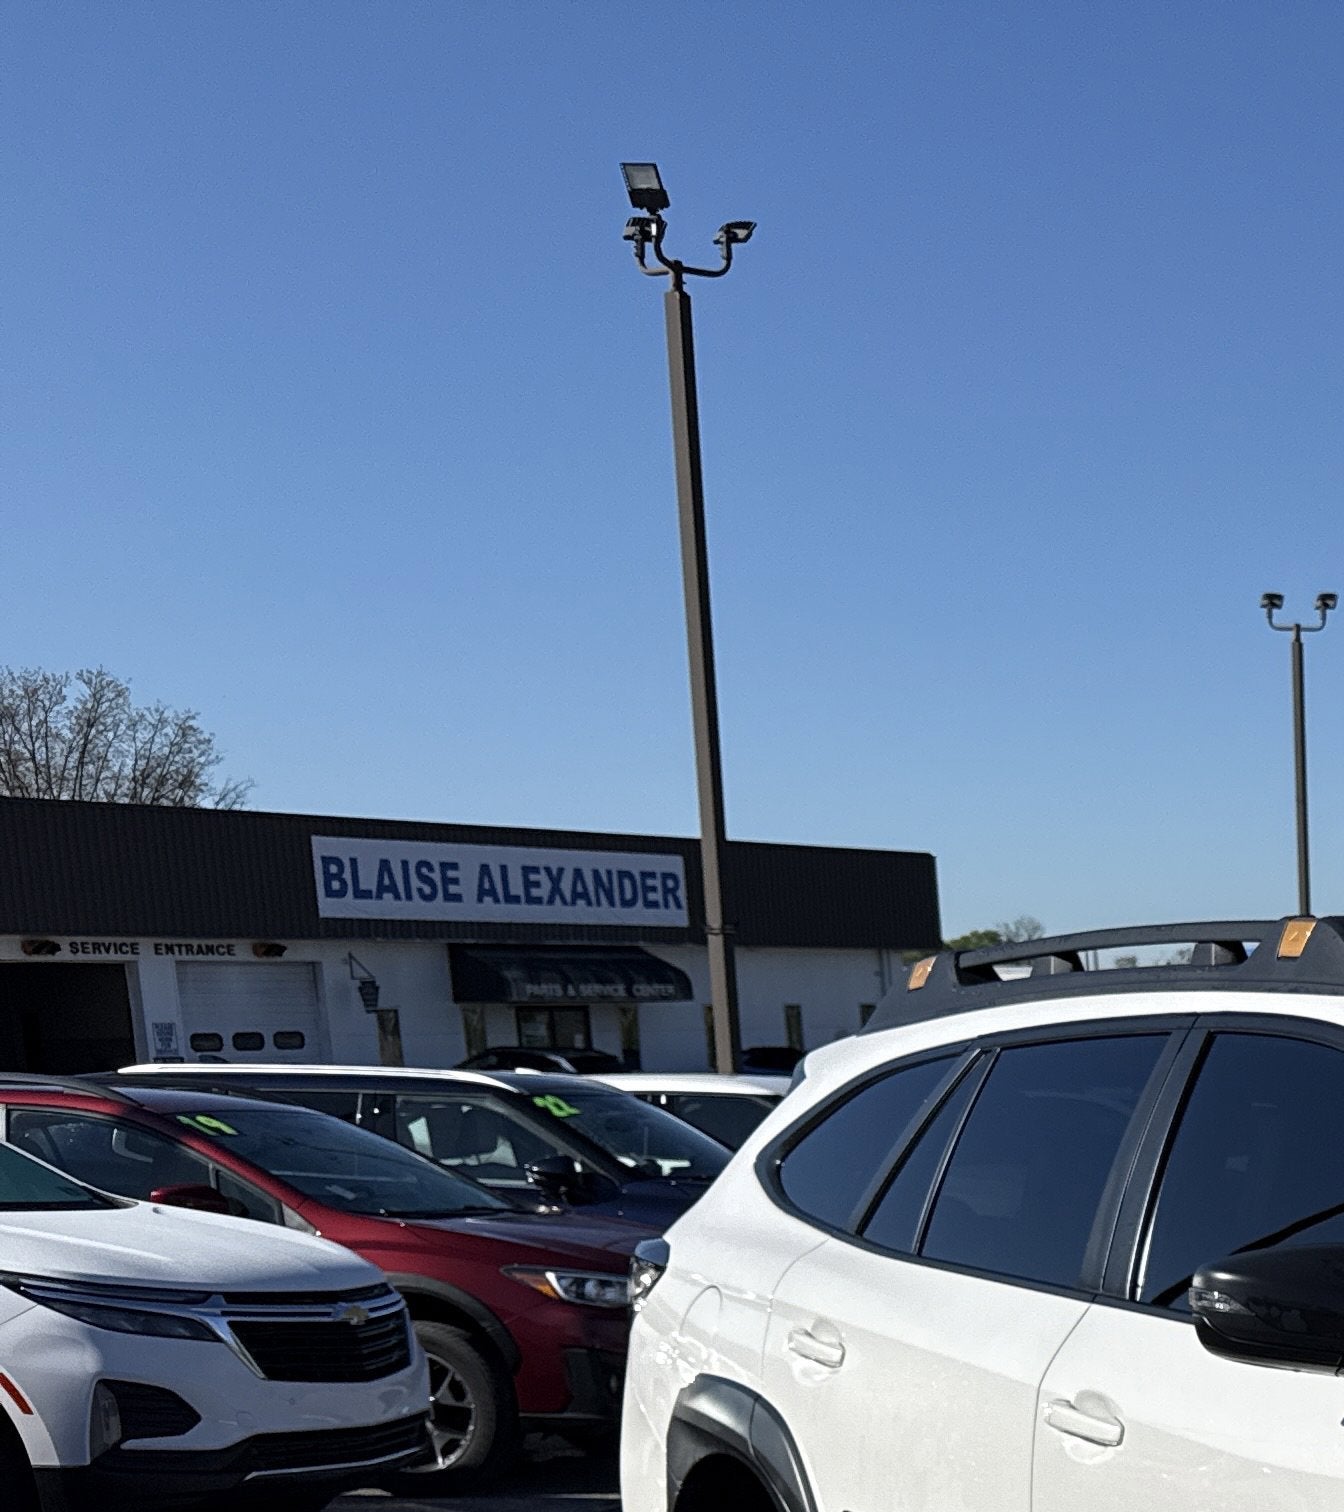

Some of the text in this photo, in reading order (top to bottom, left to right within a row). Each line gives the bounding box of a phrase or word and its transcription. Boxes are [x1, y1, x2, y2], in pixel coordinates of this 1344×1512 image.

[320, 855, 684, 910] BLAISE ALEXANDER
[69, 941, 236, 957] SERVICE ENTRANCE
[526, 983, 563, 997] PARTS
[579, 983, 627, 997] SERVICE
[631, 983, 676, 997] CENTER
